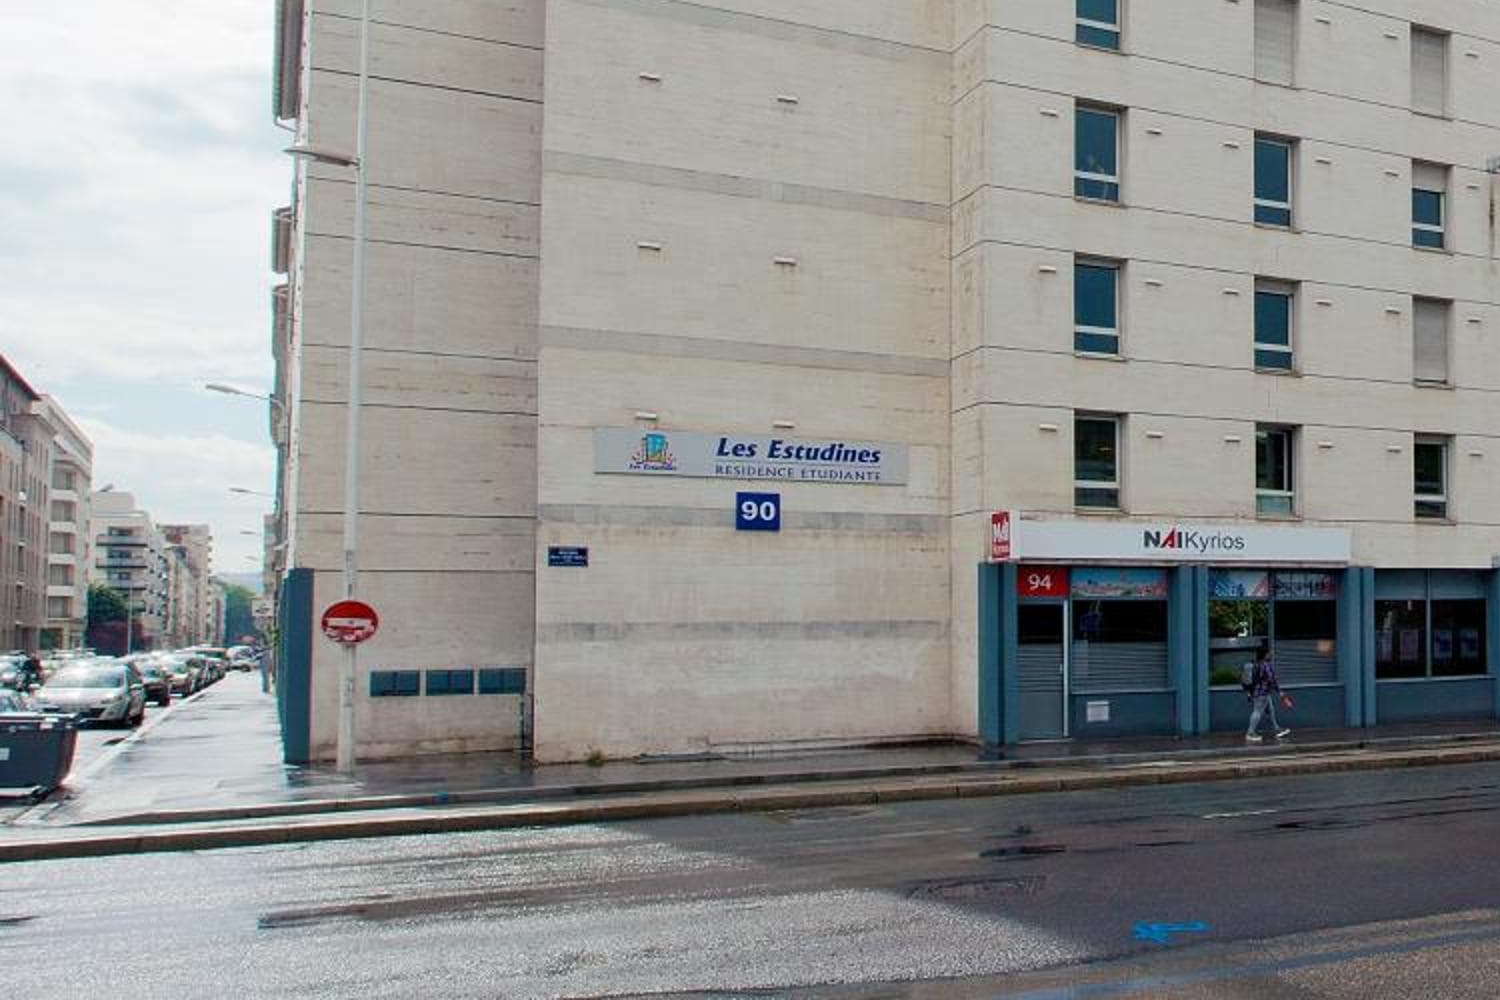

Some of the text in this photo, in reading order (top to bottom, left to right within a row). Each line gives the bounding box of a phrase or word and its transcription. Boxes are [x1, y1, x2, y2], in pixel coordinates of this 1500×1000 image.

[717, 437, 881, 462] Les Estudines
[741, 501, 776, 521] 90
[1027, 573, 1051, 590] 94
